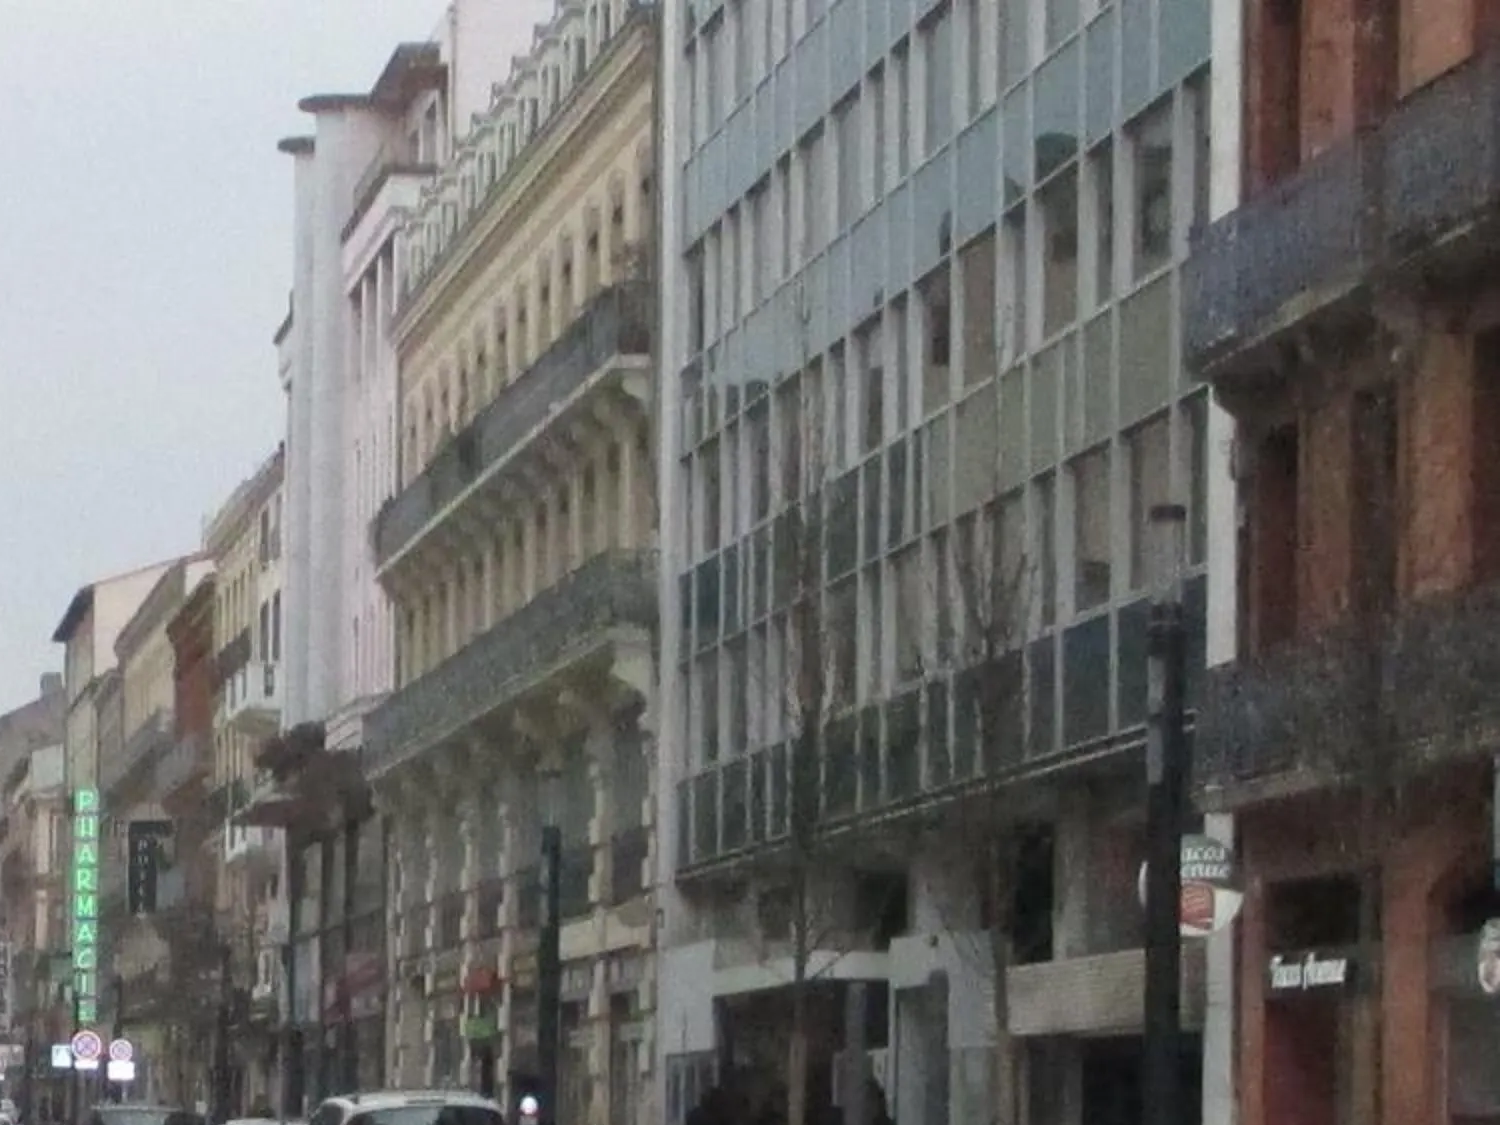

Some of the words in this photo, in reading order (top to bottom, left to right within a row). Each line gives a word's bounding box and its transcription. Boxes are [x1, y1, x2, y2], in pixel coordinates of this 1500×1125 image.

[1180, 846, 1226, 862] acos
[1180, 862, 1232, 878] enue
[75, 789, 97, 1021] PHARMACIE
